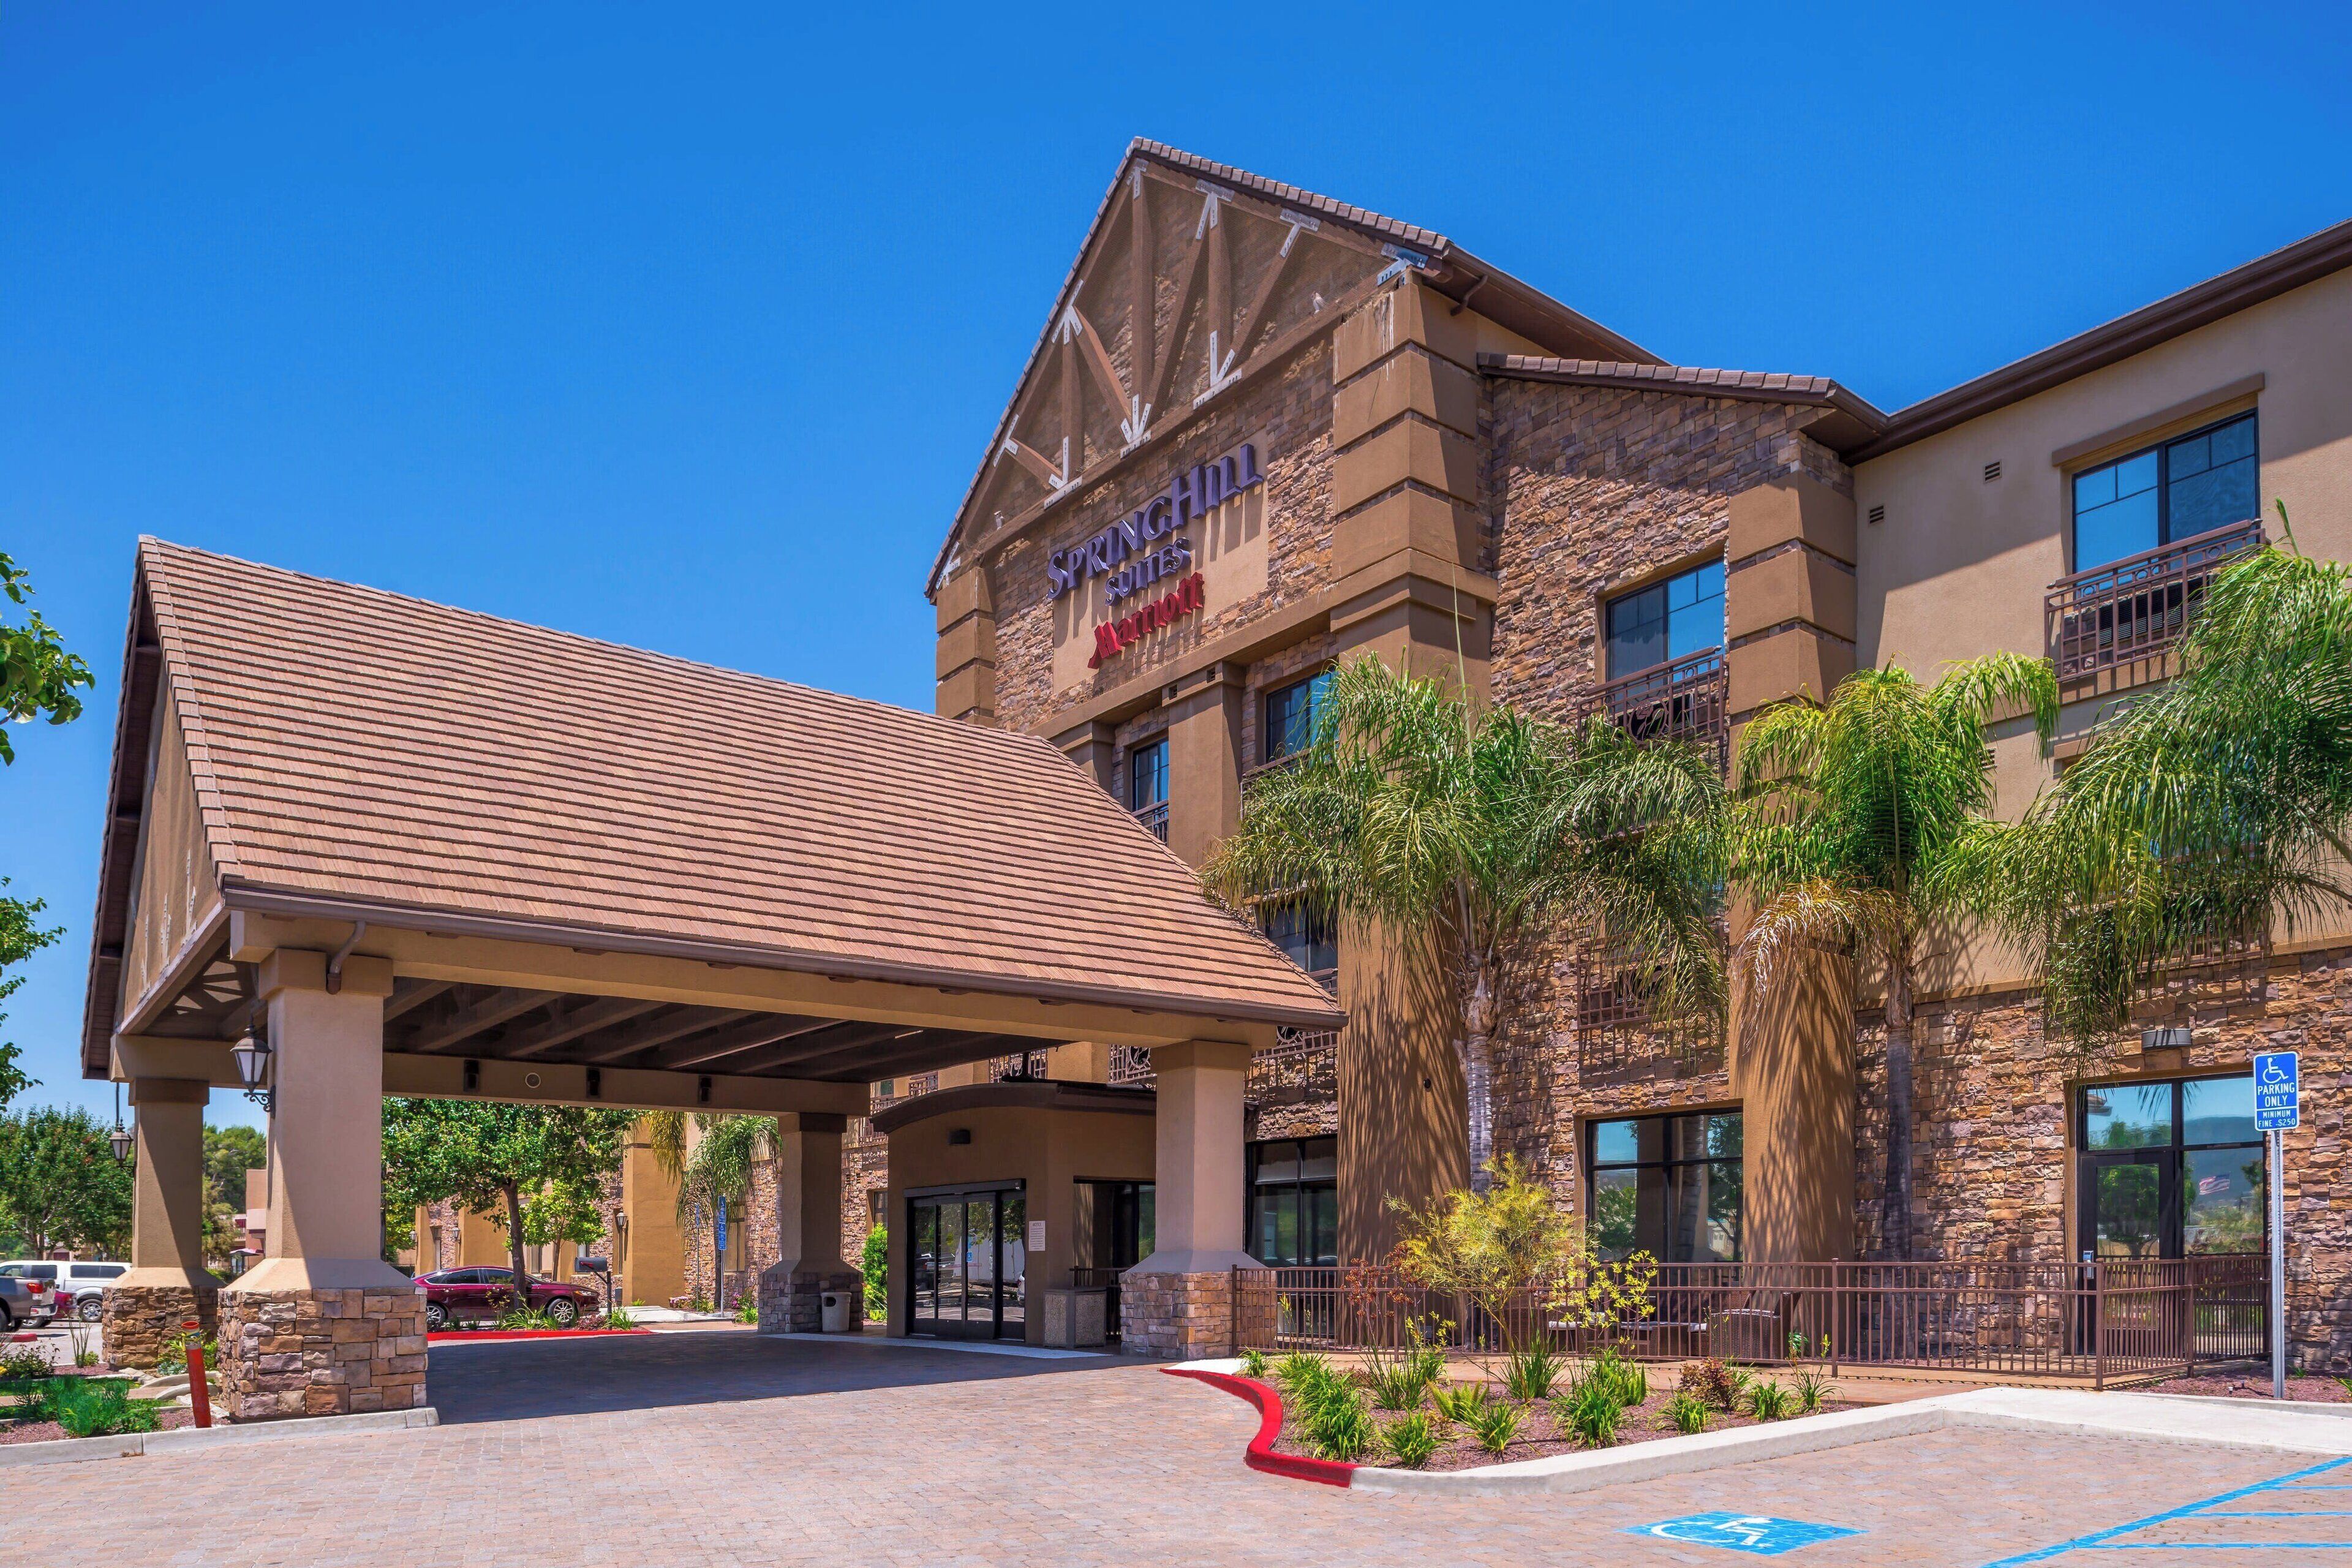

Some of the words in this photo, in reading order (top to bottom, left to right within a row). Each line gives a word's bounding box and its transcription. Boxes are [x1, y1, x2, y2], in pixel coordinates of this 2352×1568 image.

[1105, 537, 1191, 606] SUITES
[1088, 572, 1204, 669] Marriott
[2257, 1082, 2295, 1095] PARKING
[2265, 1095, 2288, 1107] ONLY
[2263, 1110, 2291, 1118] MINIMUM
